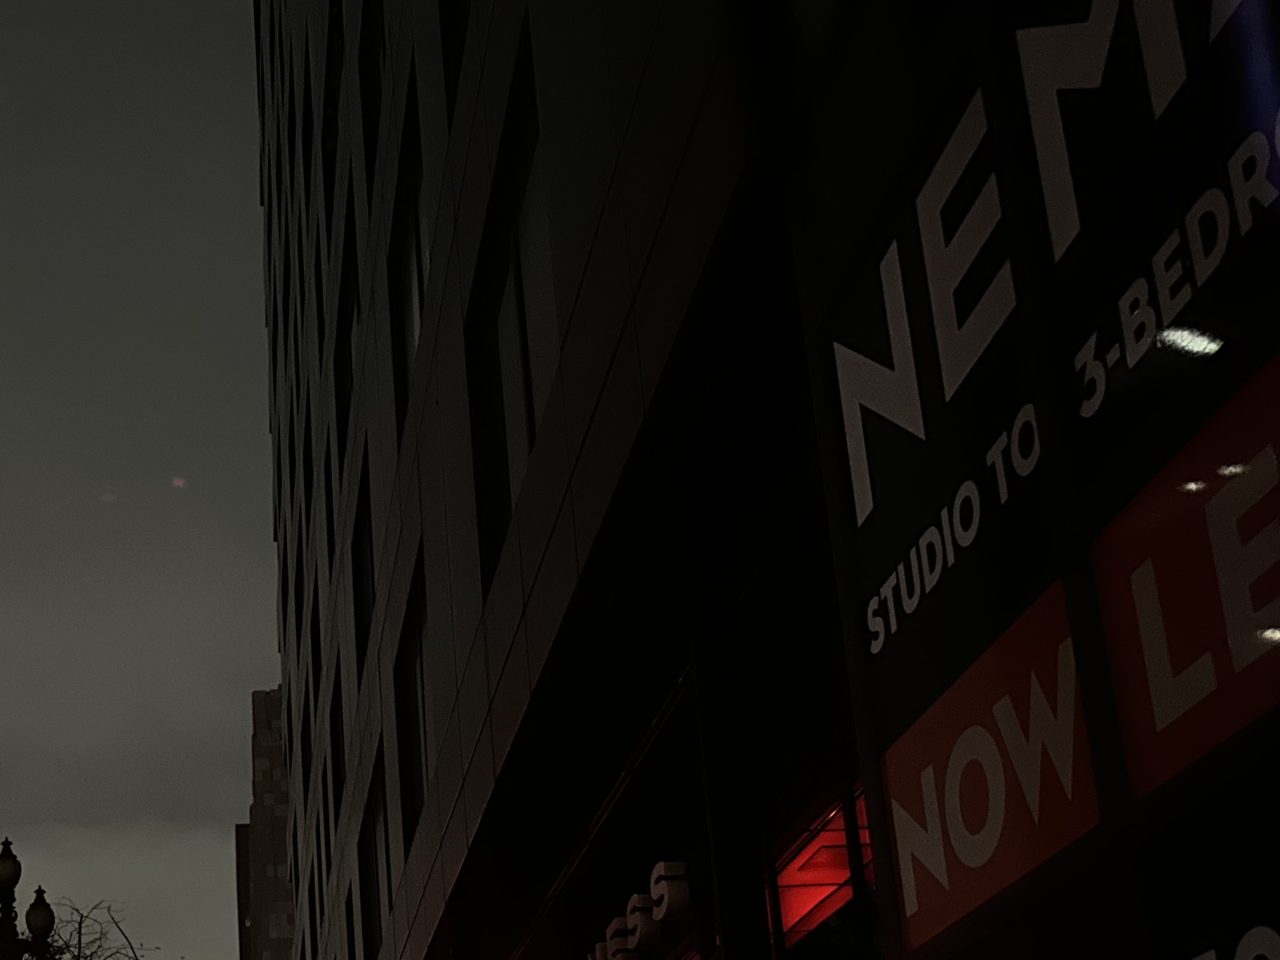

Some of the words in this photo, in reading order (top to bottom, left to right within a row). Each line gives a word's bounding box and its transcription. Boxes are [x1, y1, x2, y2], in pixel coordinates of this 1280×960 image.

[833, 0, 1243, 527] NEM
[865, 480, 982, 655] STUDIO
[986, 403, 1041, 505] TO
[1074, 108, 1280, 419] 3-BEDR
[891, 635, 1078, 917] NOW
